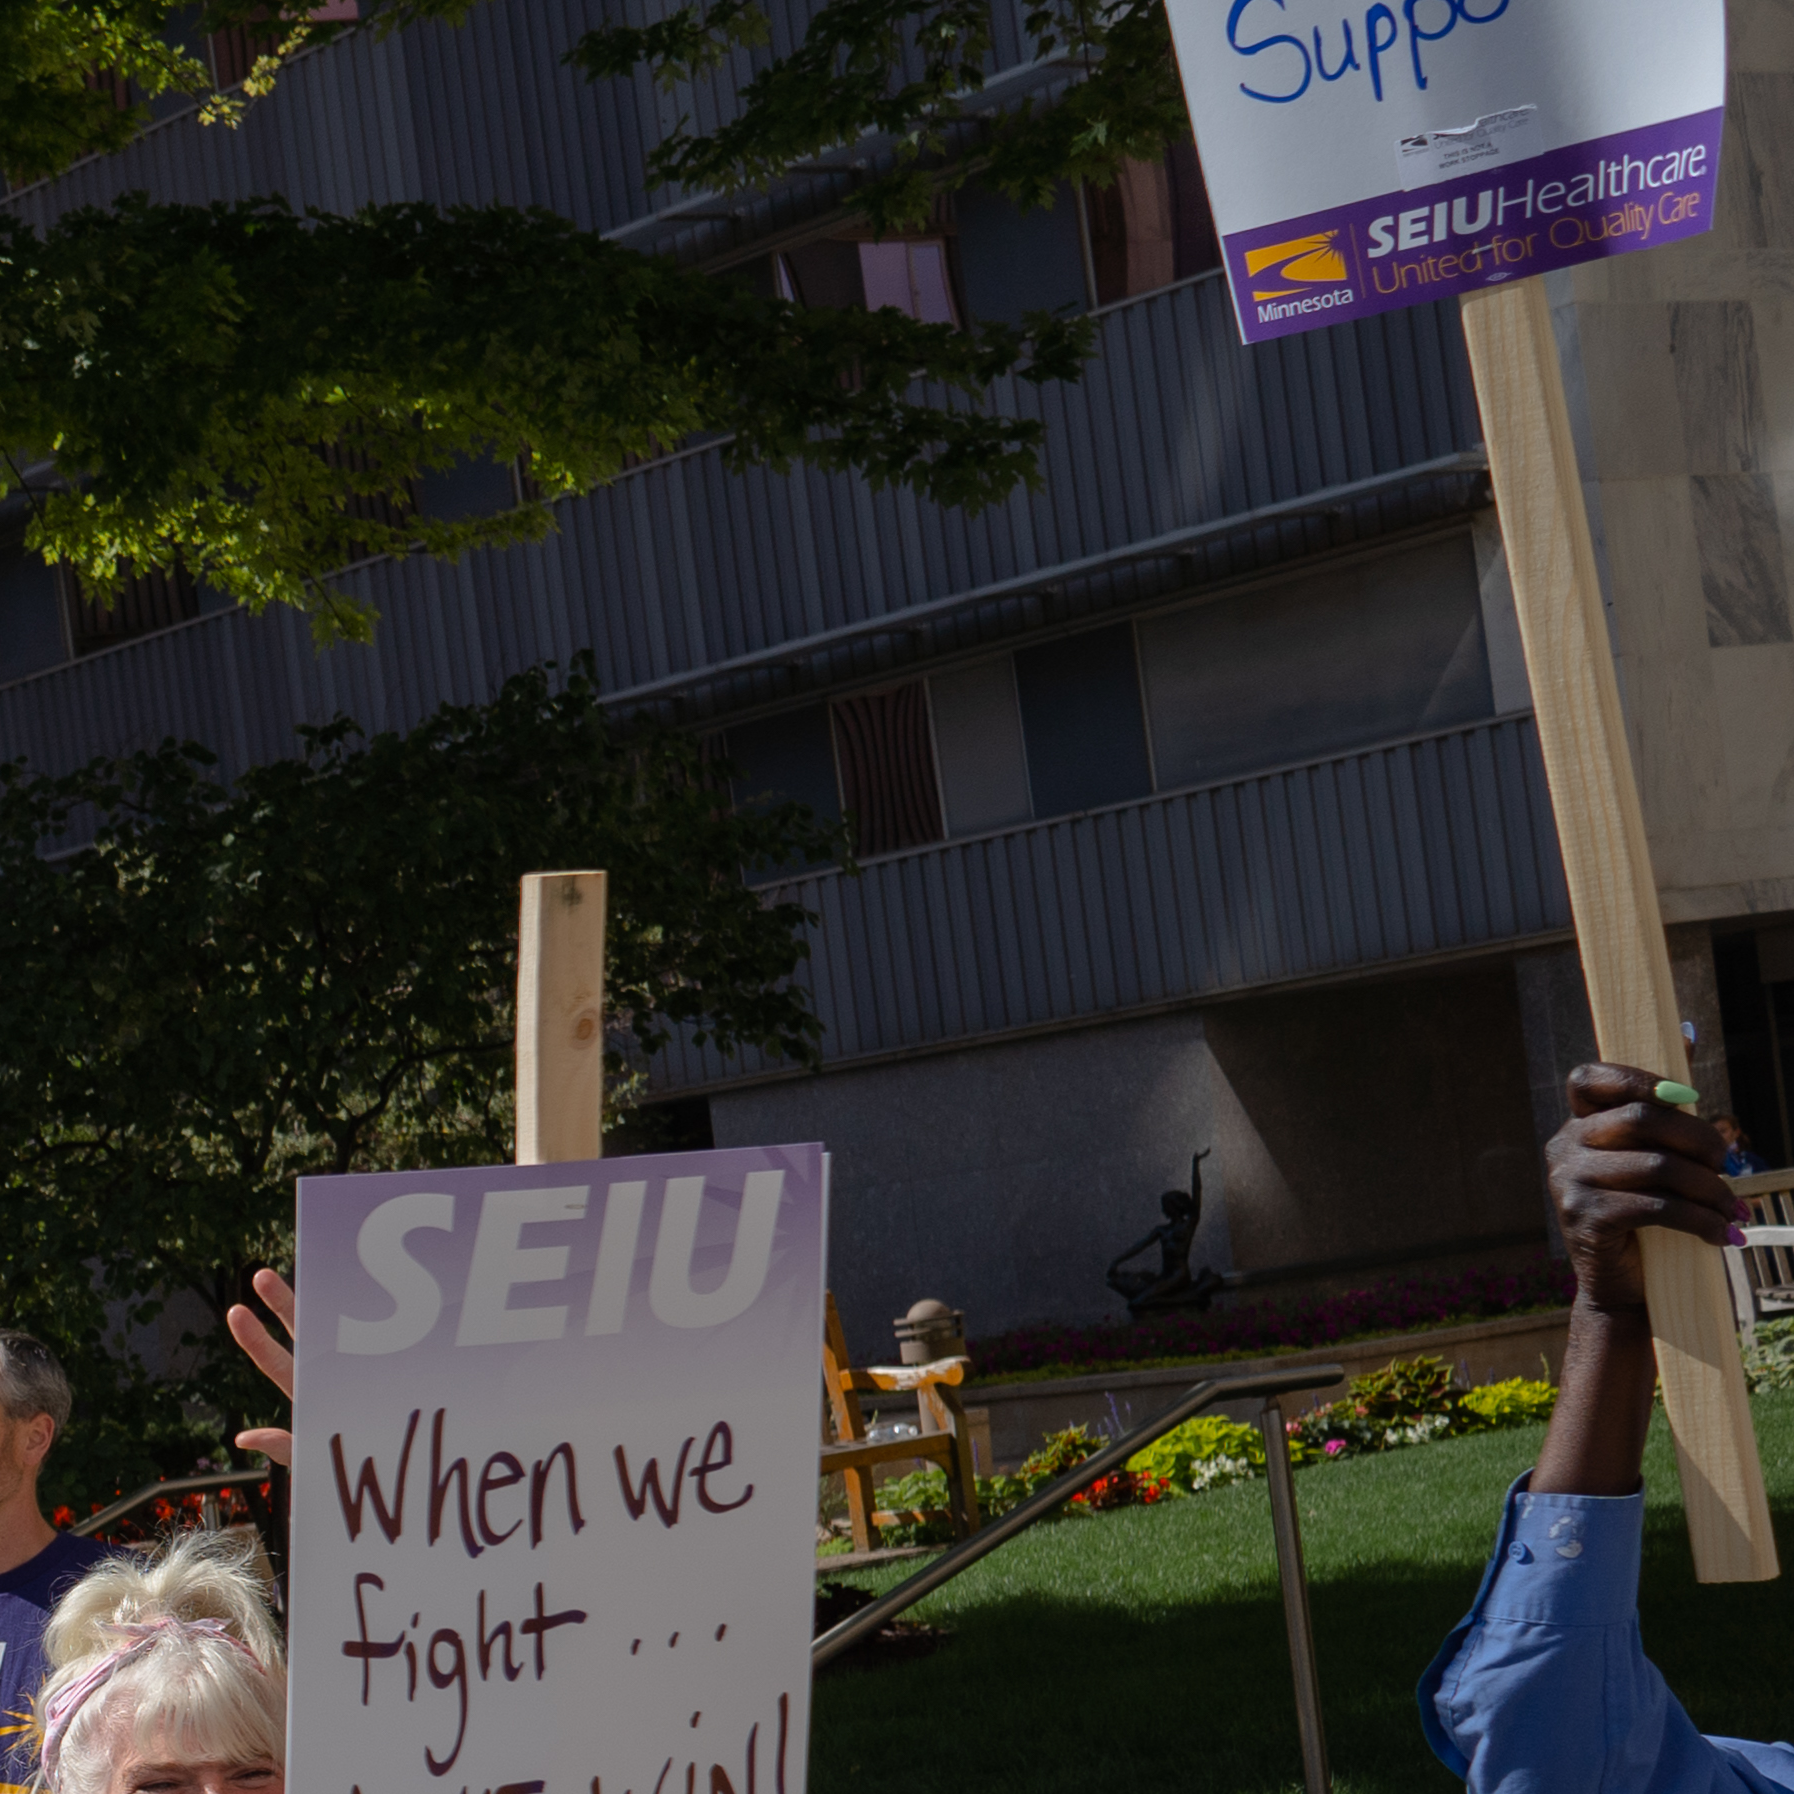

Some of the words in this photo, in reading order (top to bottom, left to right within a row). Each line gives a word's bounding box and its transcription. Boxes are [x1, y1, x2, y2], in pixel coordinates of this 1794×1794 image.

[1368, 143, 1707, 258] SEIUHealthcare
[1371, 240, 1485, 296] United
[1486, 229, 1536, 265] for
[1549, 199, 1655, 250] Quality
[1658, 190, 1701, 223] Care
[1257, 287, 1354, 324] Minnesota
[336, 1170, 786, 1356] SEIU
[330, 1408, 586, 1558] When
[614, 1420, 755, 1528] we
[343, 1572, 587, 1777] fight
